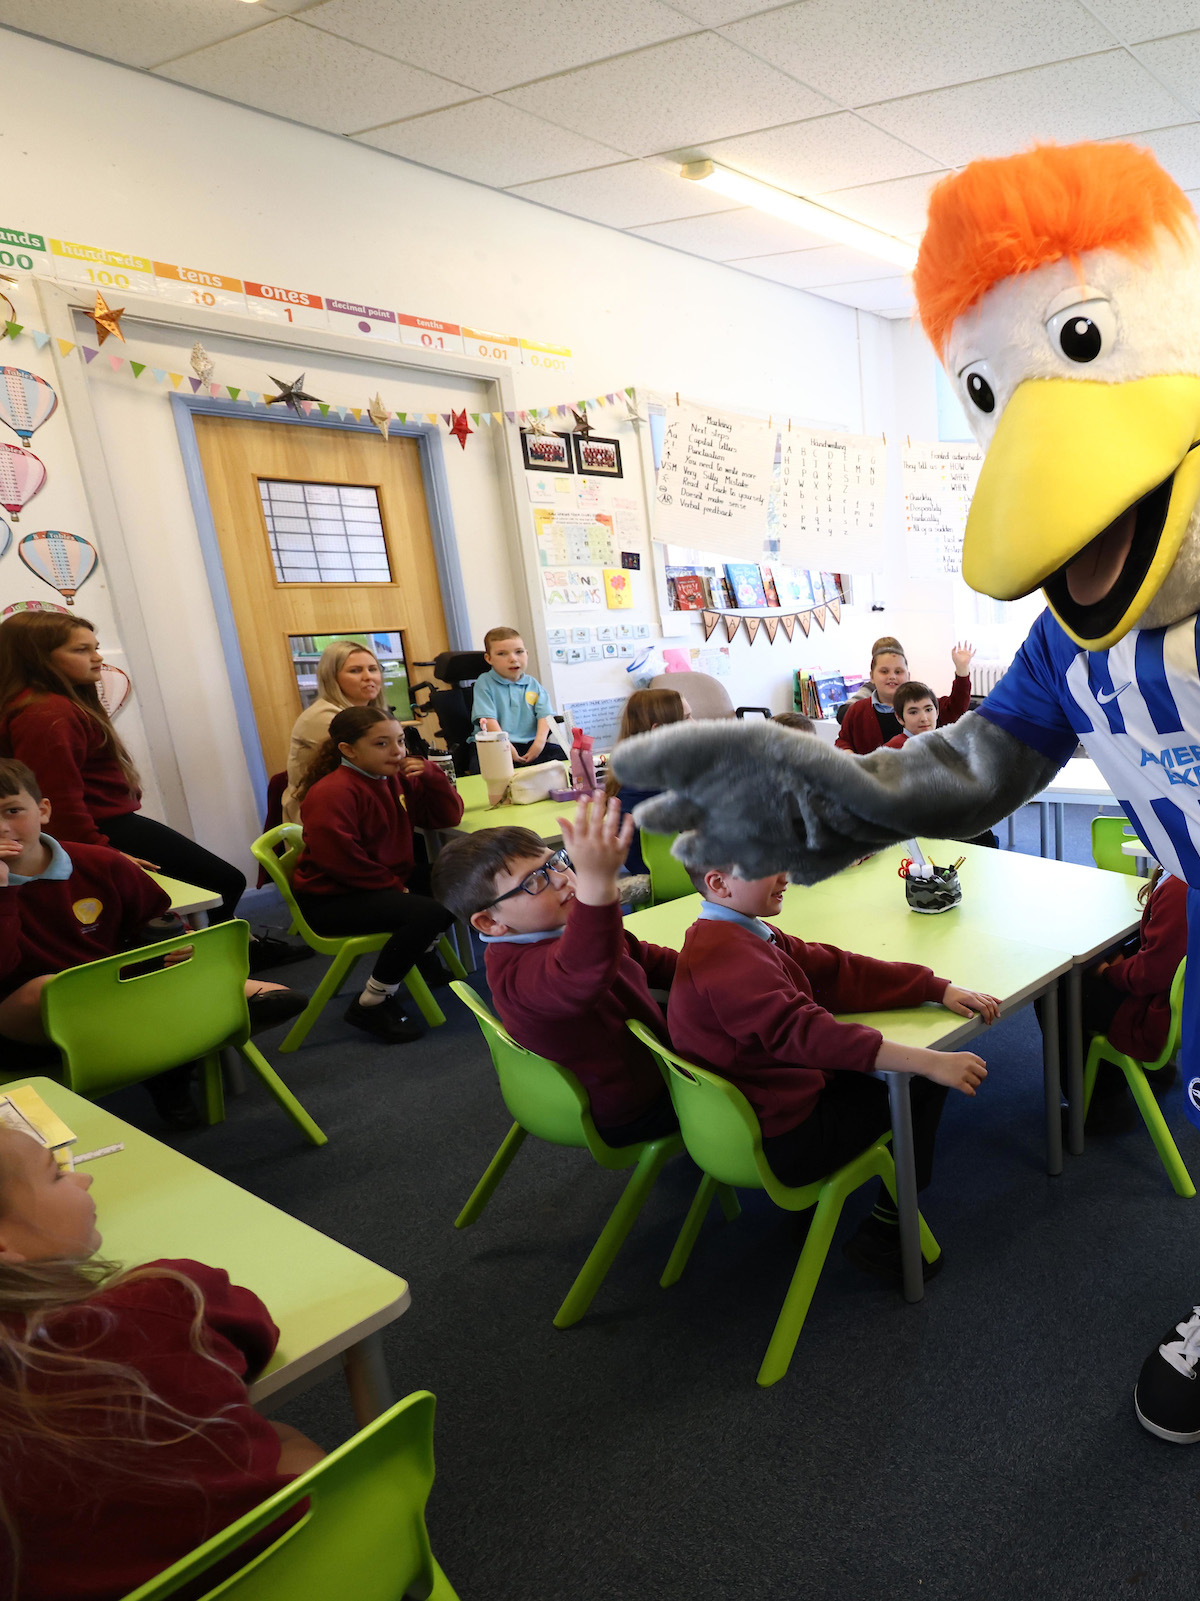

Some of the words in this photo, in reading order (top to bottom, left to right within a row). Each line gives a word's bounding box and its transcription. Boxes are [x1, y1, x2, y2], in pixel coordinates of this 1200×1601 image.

[61, 242, 144, 270] hundreds
[86, 268, 130, 290] 100
[177, 266, 223, 288] tens
[190, 290, 216, 307] 10
[260, 284, 311, 308] ones
[284, 308, 293, 323] 1
[331, 300, 366, 315] decimal
[367, 307, 390, 320] point
[416, 318, 443, 331] tenths
[420, 333, 445, 350] 0.1
[479, 345, 508, 360] 0.01
[530, 355, 566, 371] 0.001
[684, 455, 698, 467] You
[660, 459, 678, 473] VSM
[682, 465, 698, 481] Very
[702, 470, 719, 485] Silly
[682, 477, 698, 488] Read
[711, 482, 727, 495] back
[679, 497, 701, 511] Verbal
[702, 505, 734, 518] feedback
[544, 571, 568, 587] BE
